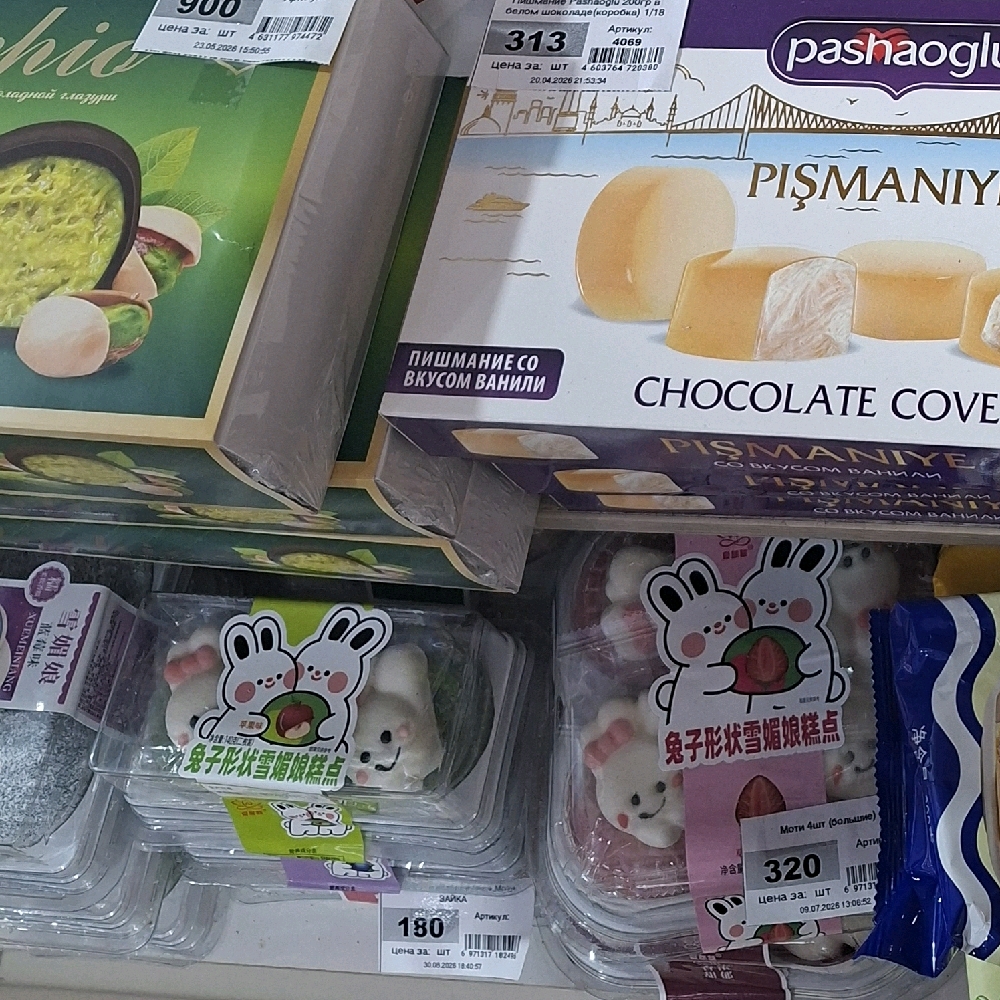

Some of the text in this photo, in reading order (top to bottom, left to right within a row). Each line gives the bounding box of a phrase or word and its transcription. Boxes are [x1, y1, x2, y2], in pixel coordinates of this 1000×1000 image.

[505, 8, 665, 18] белом шоколаде(коробка) 1/18
[158, 24, 237, 38] цена за: шт
[504, 25, 653, 52] 313 Артикул:
[612, 37, 642, 47] 4069
[491, 62, 569, 71] цена за: шт
[407, 349, 539, 371] ПИШМАНИЕ СО
[403, 370, 546, 394] ВКУСОМ ВАНИЛИ
[634, 375, 877, 418] CHOCOLATE
[659, 437, 977, 470] PIŞMANIYE
[665, 709, 841, 766] 兔子形状雪媚娘糕点
[183, 741, 346, 787] 兔子形状雪媚娘糕点
[780, 810, 877, 835] Моти 4шт (большие)
[763, 853, 822, 884] 320
[439, 894, 468, 903] ЗАЙКА
[758, 887, 831, 905] цена за: шт
[398, 912, 510, 939] 180 Артикул:
[391, 947, 451, 956] цена за: шт
